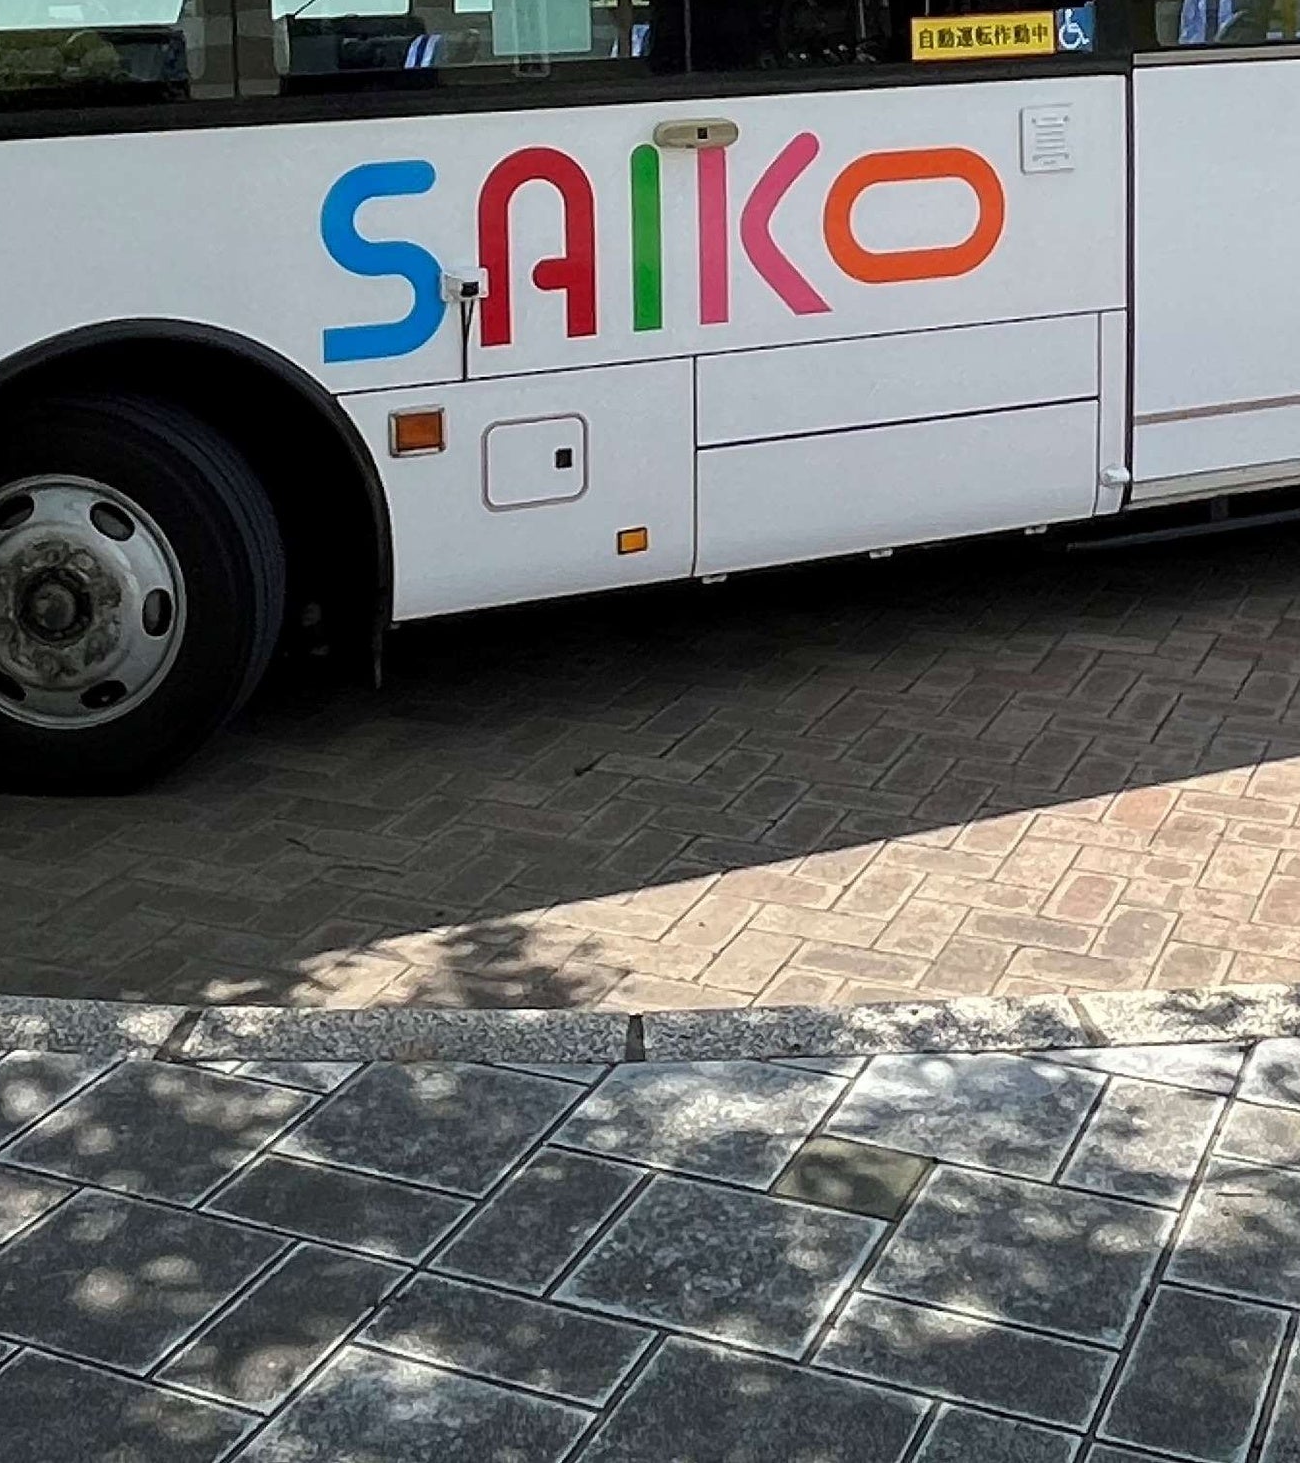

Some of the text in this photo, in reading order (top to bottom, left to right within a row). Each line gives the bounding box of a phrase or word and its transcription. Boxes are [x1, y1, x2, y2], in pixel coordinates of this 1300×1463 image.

[918, 22, 1049, 50] 自動運転作動中
[320, 131, 1006, 364] SAIKO
